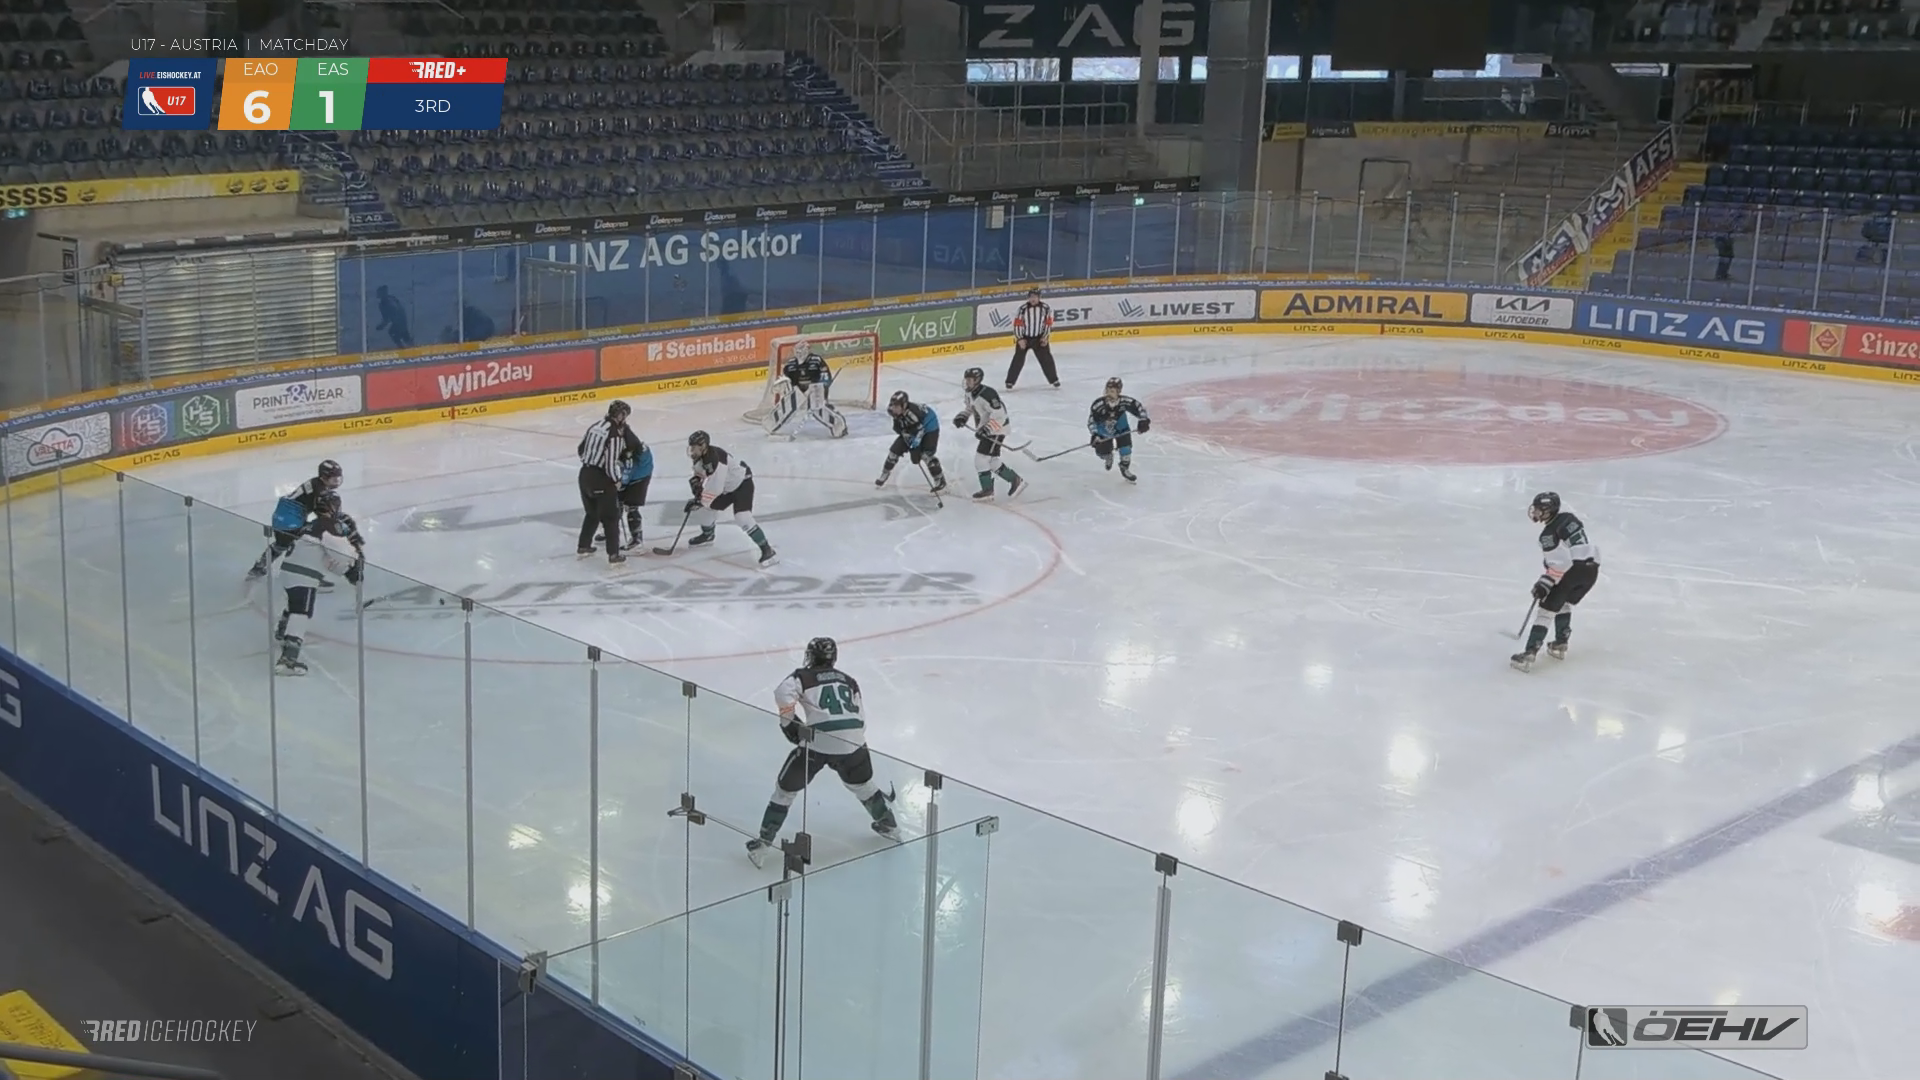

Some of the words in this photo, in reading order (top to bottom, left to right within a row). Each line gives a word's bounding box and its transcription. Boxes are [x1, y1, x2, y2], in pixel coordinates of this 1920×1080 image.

[1057, 3, 1196, 48] AG
[548, 239, 630, 272] LINZ
[639, 233, 689, 268] AG
[699, 230, 802, 263] Sektor
[1150, 301, 1236, 317] LIWEST
[1283, 292, 1443, 319] ADMIRAL
[900, 315, 938, 342] VKB
[1495, 314, 1549, 326] AUTOEDER
[1588, 304, 1689, 338] LINZ
[1697, 316, 1766, 346] AG
[666, 333, 756, 361] Steinbach
[1679, 348, 1703, 358] LINZ
[1704, 351, 1721, 359] AG
[1859, 331, 1920, 359] Linze
[1782, 359, 1808, 370] LINZ
[1809, 361, 1826, 371] AG
[657, 382, 682, 391] LINZ
[682, 379, 698, 388] AG
[553, 394, 578, 404] LINZ
[578, 391, 597, 400] AG
[343, 419, 371, 430] LINZ
[372, 416, 393, 426] AG
[237, 432, 267, 444] LINZ
[268, 429, 288, 439] AG
[132, 453, 161, 466] LINZ
[162, 448, 181, 459] AG
[818, 684, 861, 716] 49
[150, 763, 280, 906] LINZ
[291, 864, 394, 981] AG
